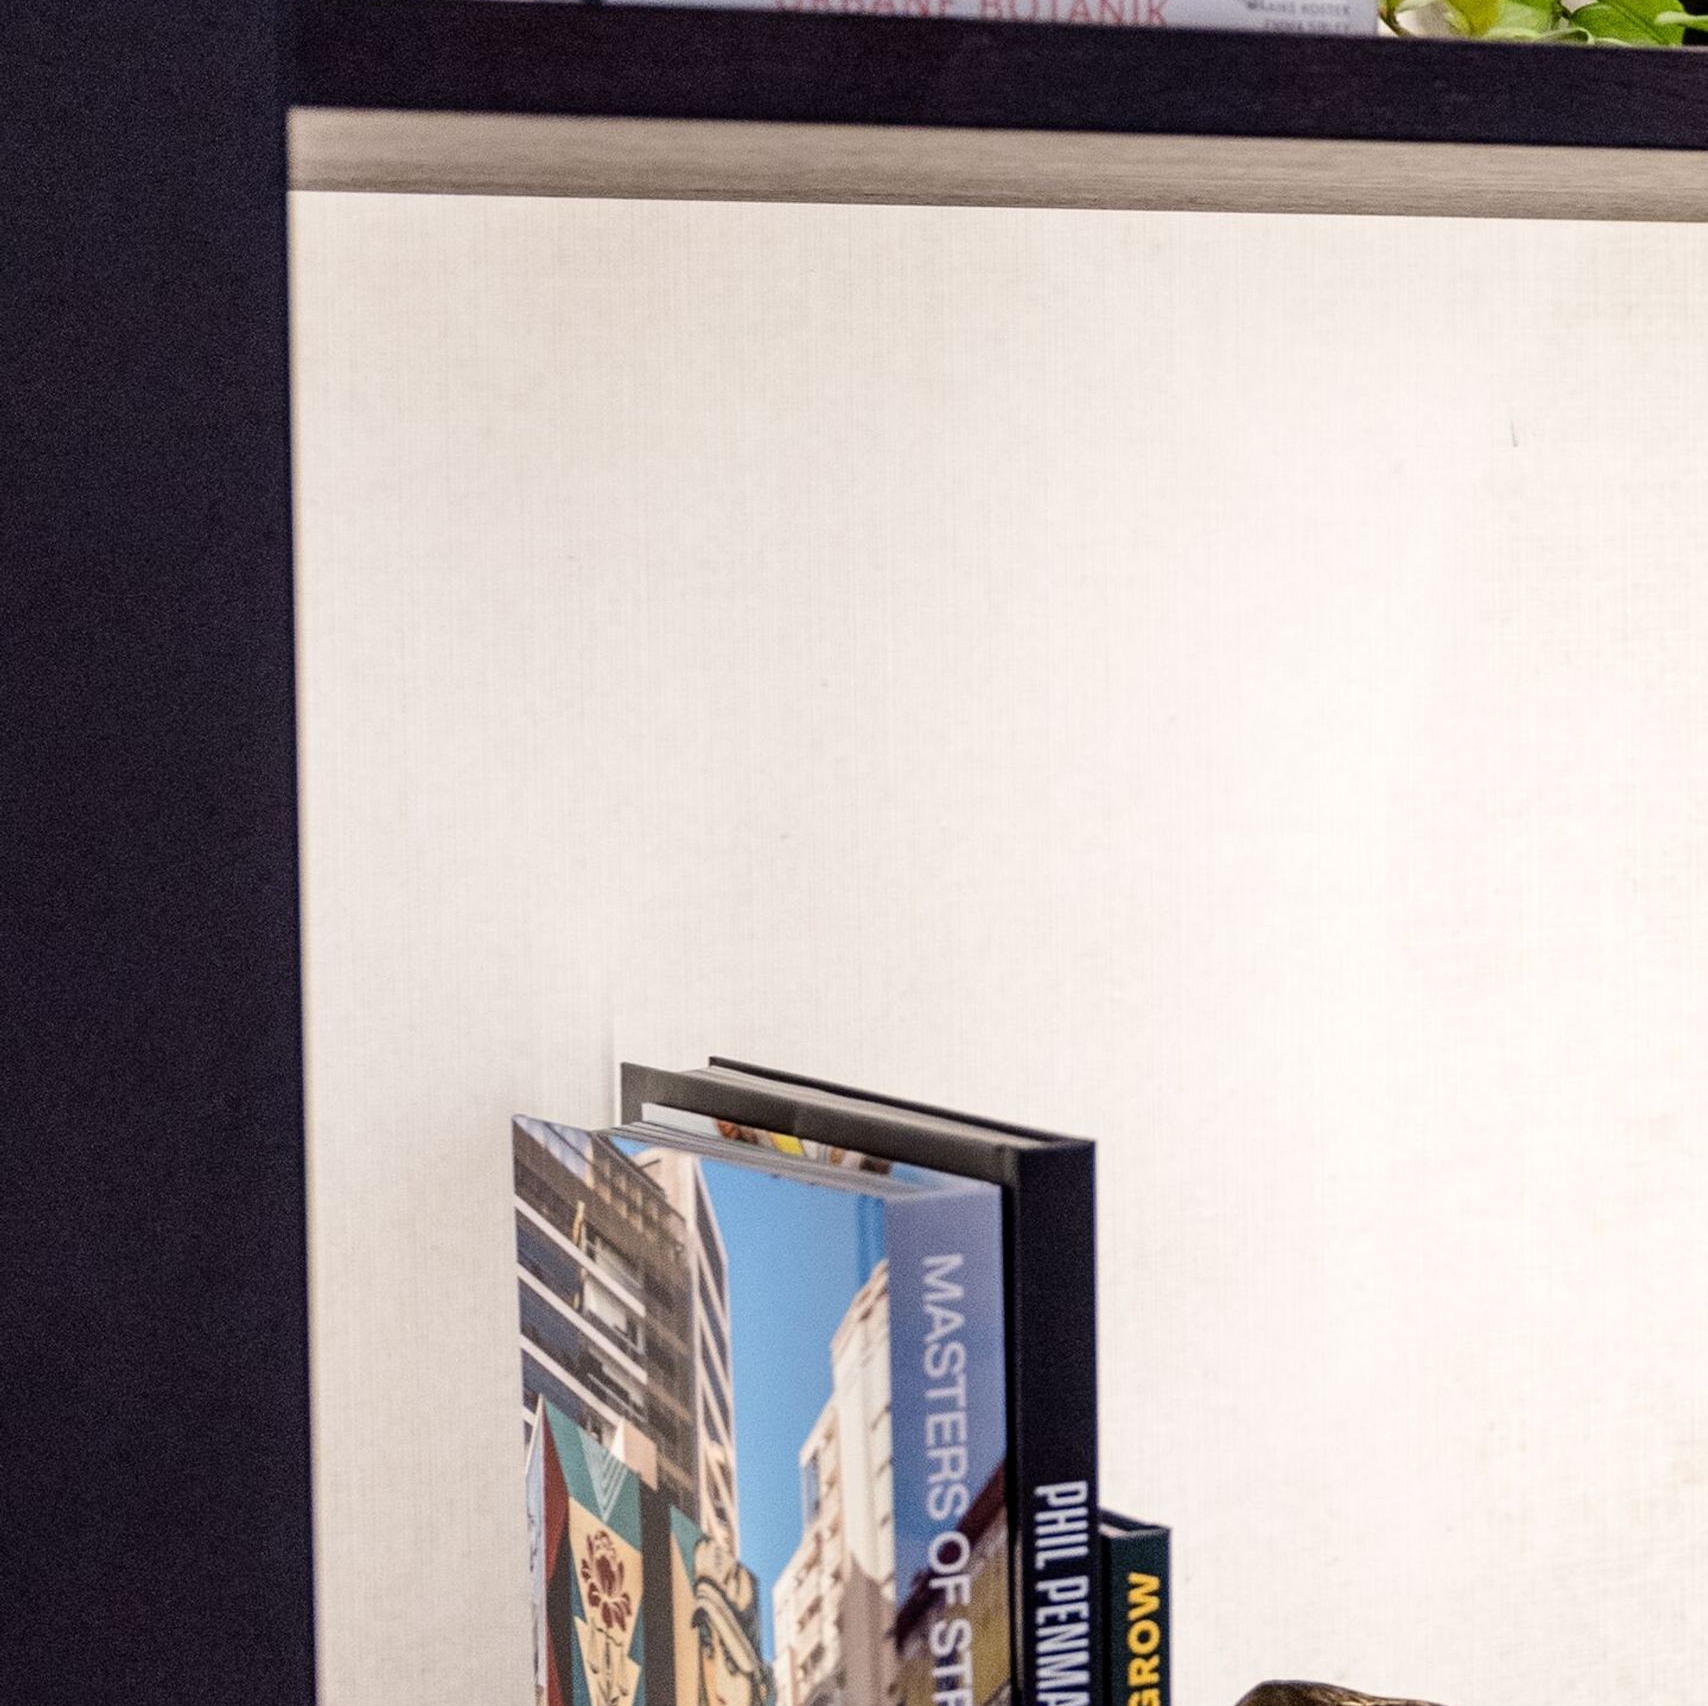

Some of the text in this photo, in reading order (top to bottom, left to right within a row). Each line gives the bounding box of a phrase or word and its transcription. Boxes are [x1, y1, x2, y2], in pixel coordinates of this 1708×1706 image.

[921, 1252, 968, 1521] MASTERS
[1034, 1480, 1088, 1566] PHIL
[928, 1529, 971, 1609] OF
